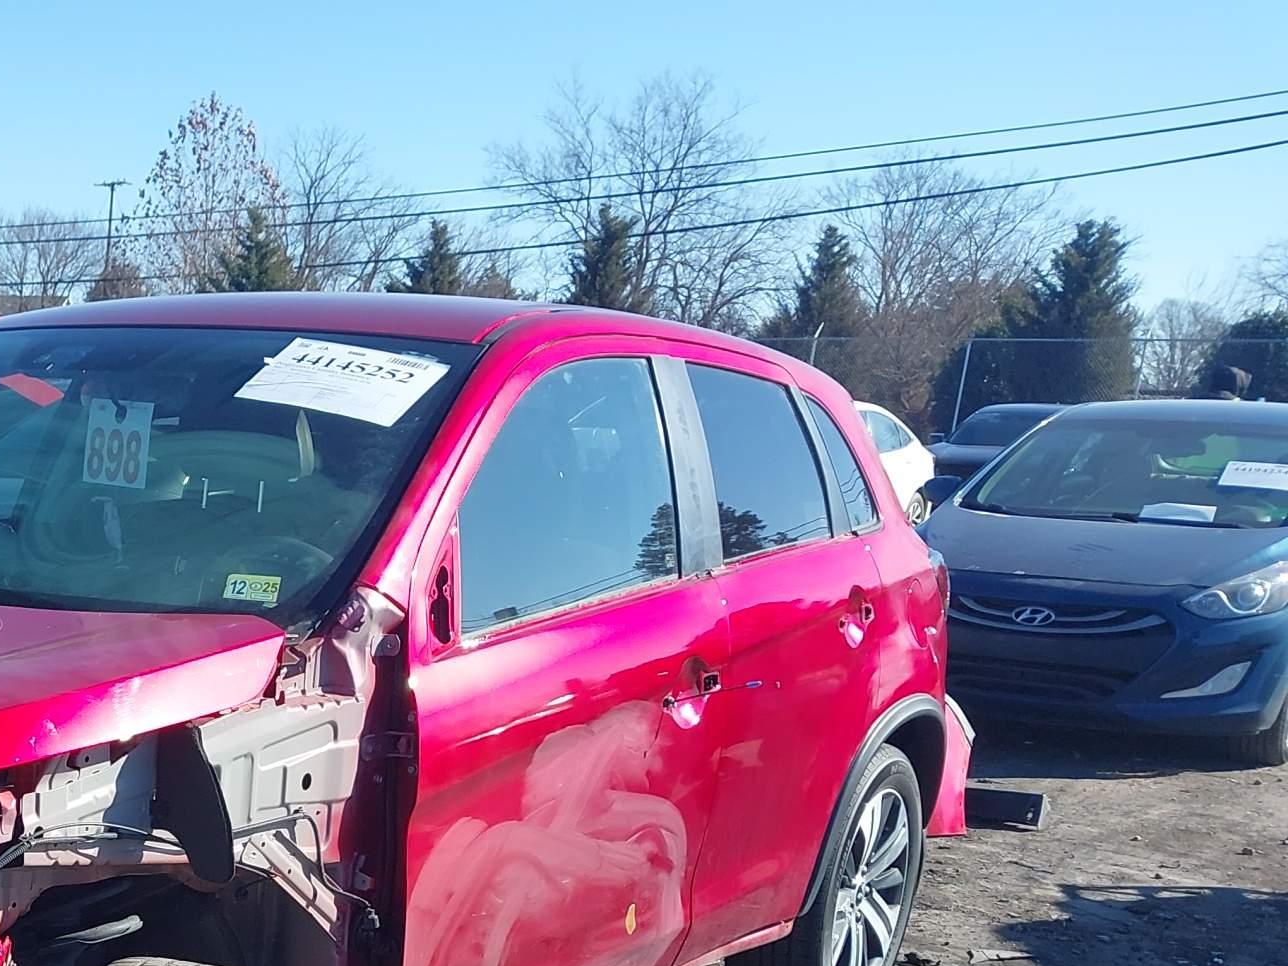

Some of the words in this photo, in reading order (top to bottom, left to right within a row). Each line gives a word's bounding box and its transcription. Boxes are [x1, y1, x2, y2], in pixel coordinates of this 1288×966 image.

[292, 352, 415, 384] 44145252
[87, 427, 141, 484] 898
[230, 580, 247, 595] 12
[263, 582, 278, 593] 25
